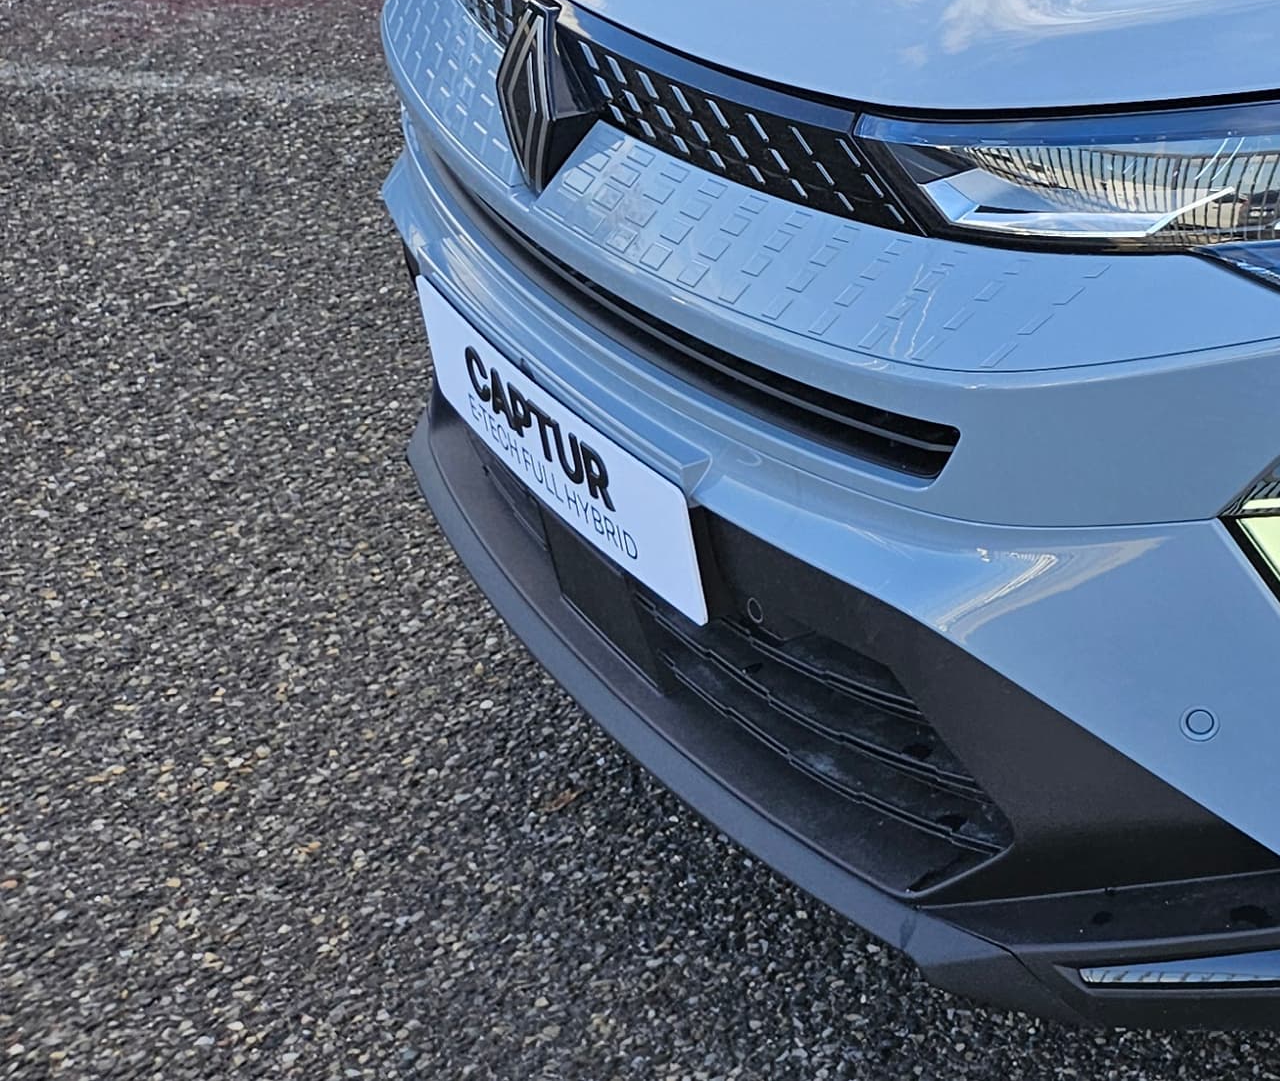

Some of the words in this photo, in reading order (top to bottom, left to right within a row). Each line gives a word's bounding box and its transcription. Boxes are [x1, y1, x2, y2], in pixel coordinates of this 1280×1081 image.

[464, 345, 616, 512] CAPTUR
[467, 393, 520, 466] E-TECH
[521, 450, 565, 508] FULL
[562, 483, 639, 560] HYBRID
